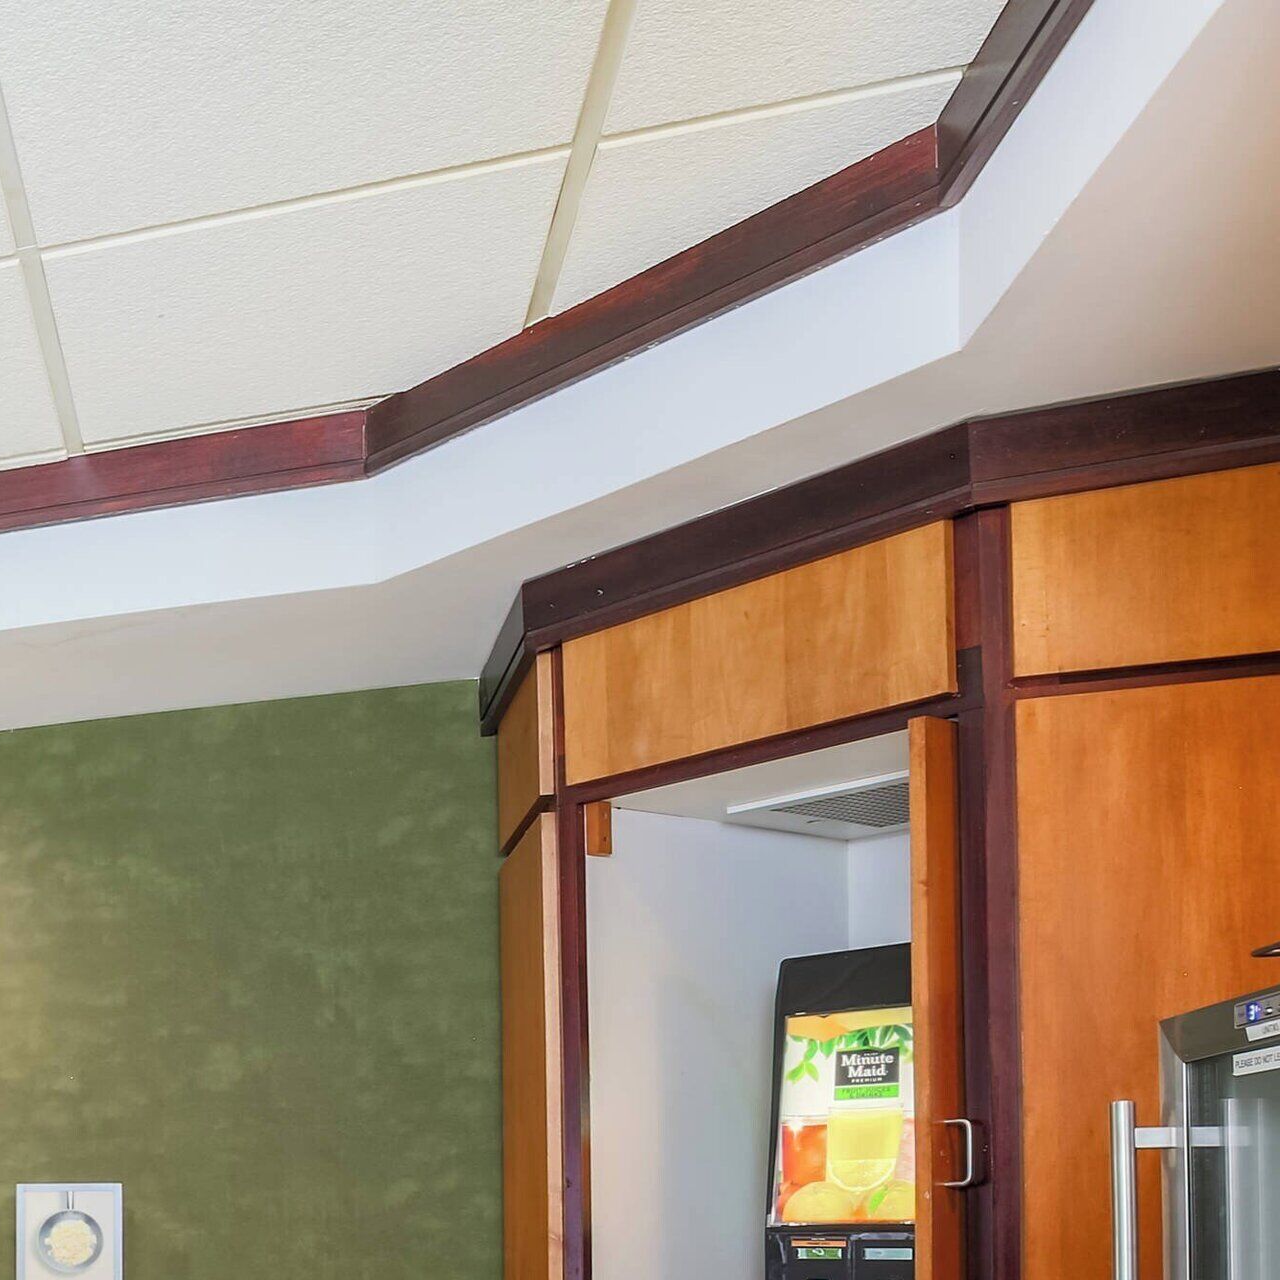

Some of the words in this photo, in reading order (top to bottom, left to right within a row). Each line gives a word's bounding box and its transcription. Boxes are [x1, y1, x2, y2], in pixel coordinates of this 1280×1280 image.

[841, 1053, 895, 1067] Minute
[1235, 1057, 1254, 1069] PLEASE
[847, 1064, 887, 1078] Maid
